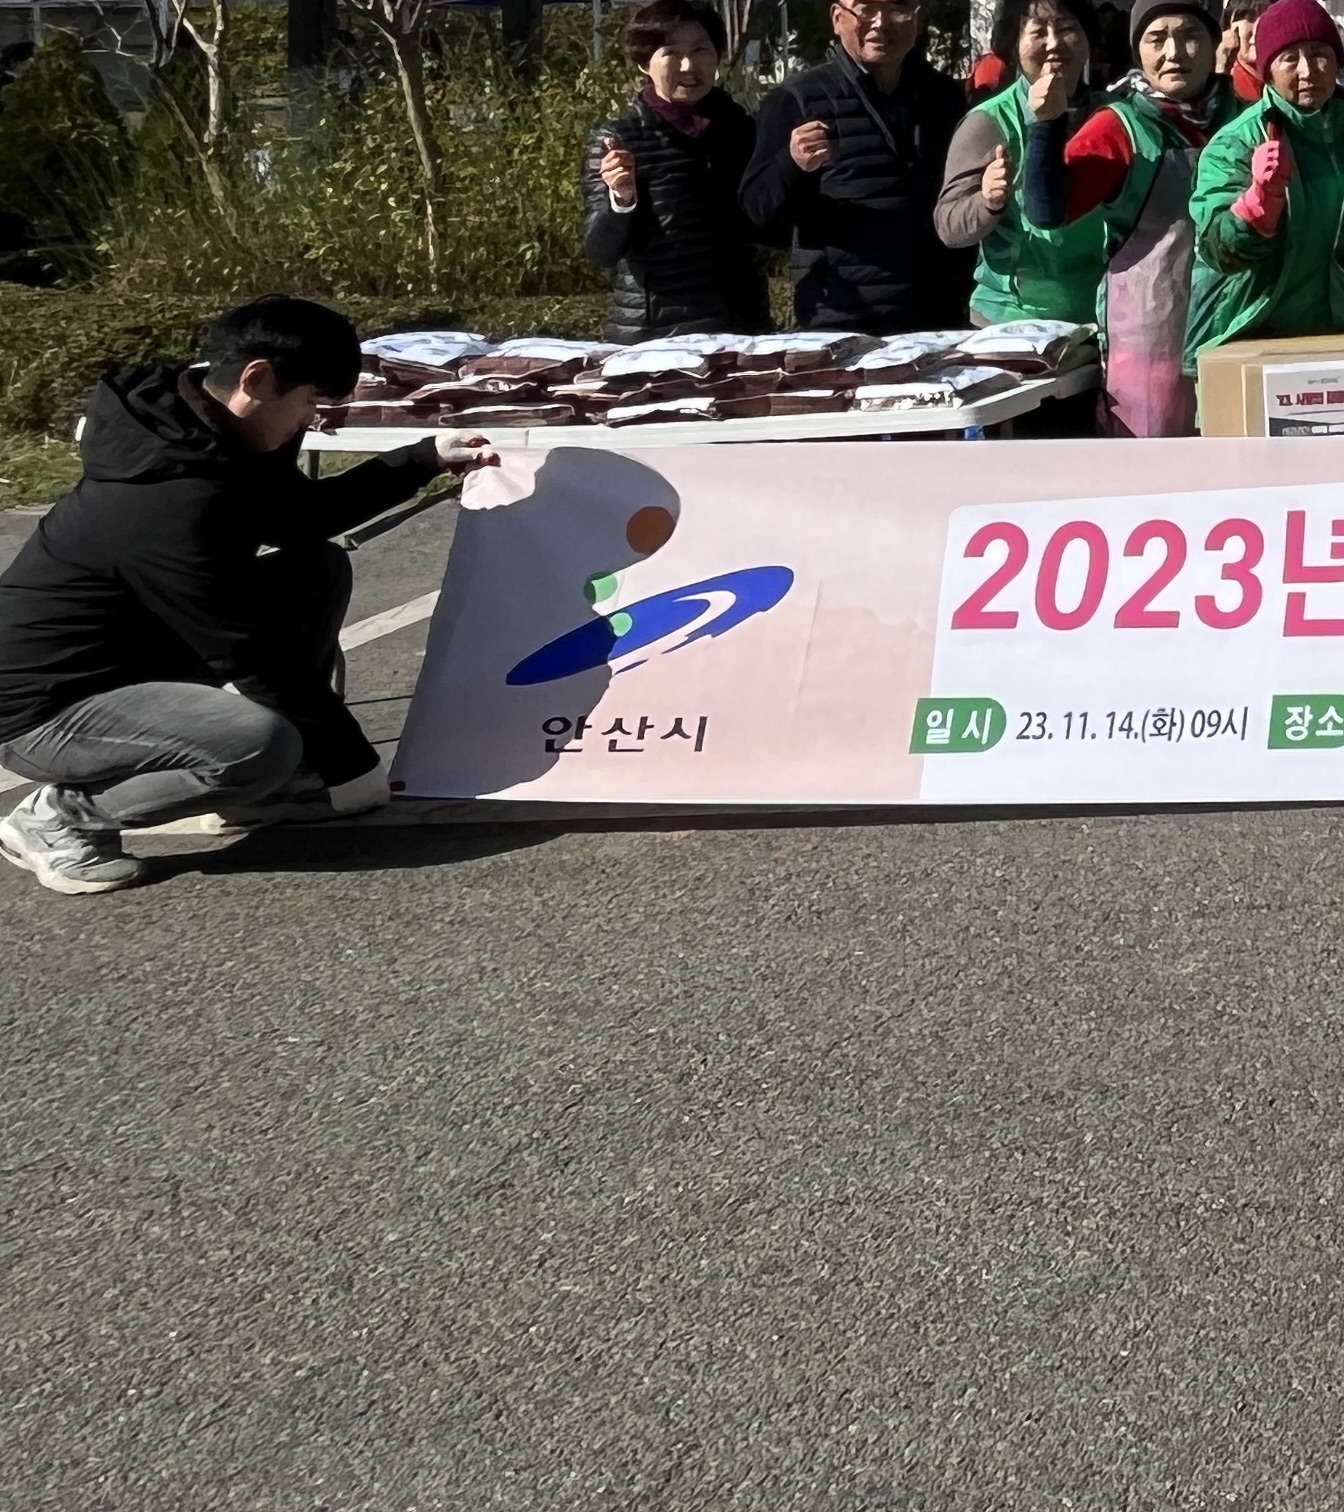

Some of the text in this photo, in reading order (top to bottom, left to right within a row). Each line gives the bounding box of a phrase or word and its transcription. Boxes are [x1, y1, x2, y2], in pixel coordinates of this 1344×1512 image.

[541, 714, 708, 754] 안산시
[925, 708, 992, 745] 일시
[1284, 705, 1344, 742] 장소
